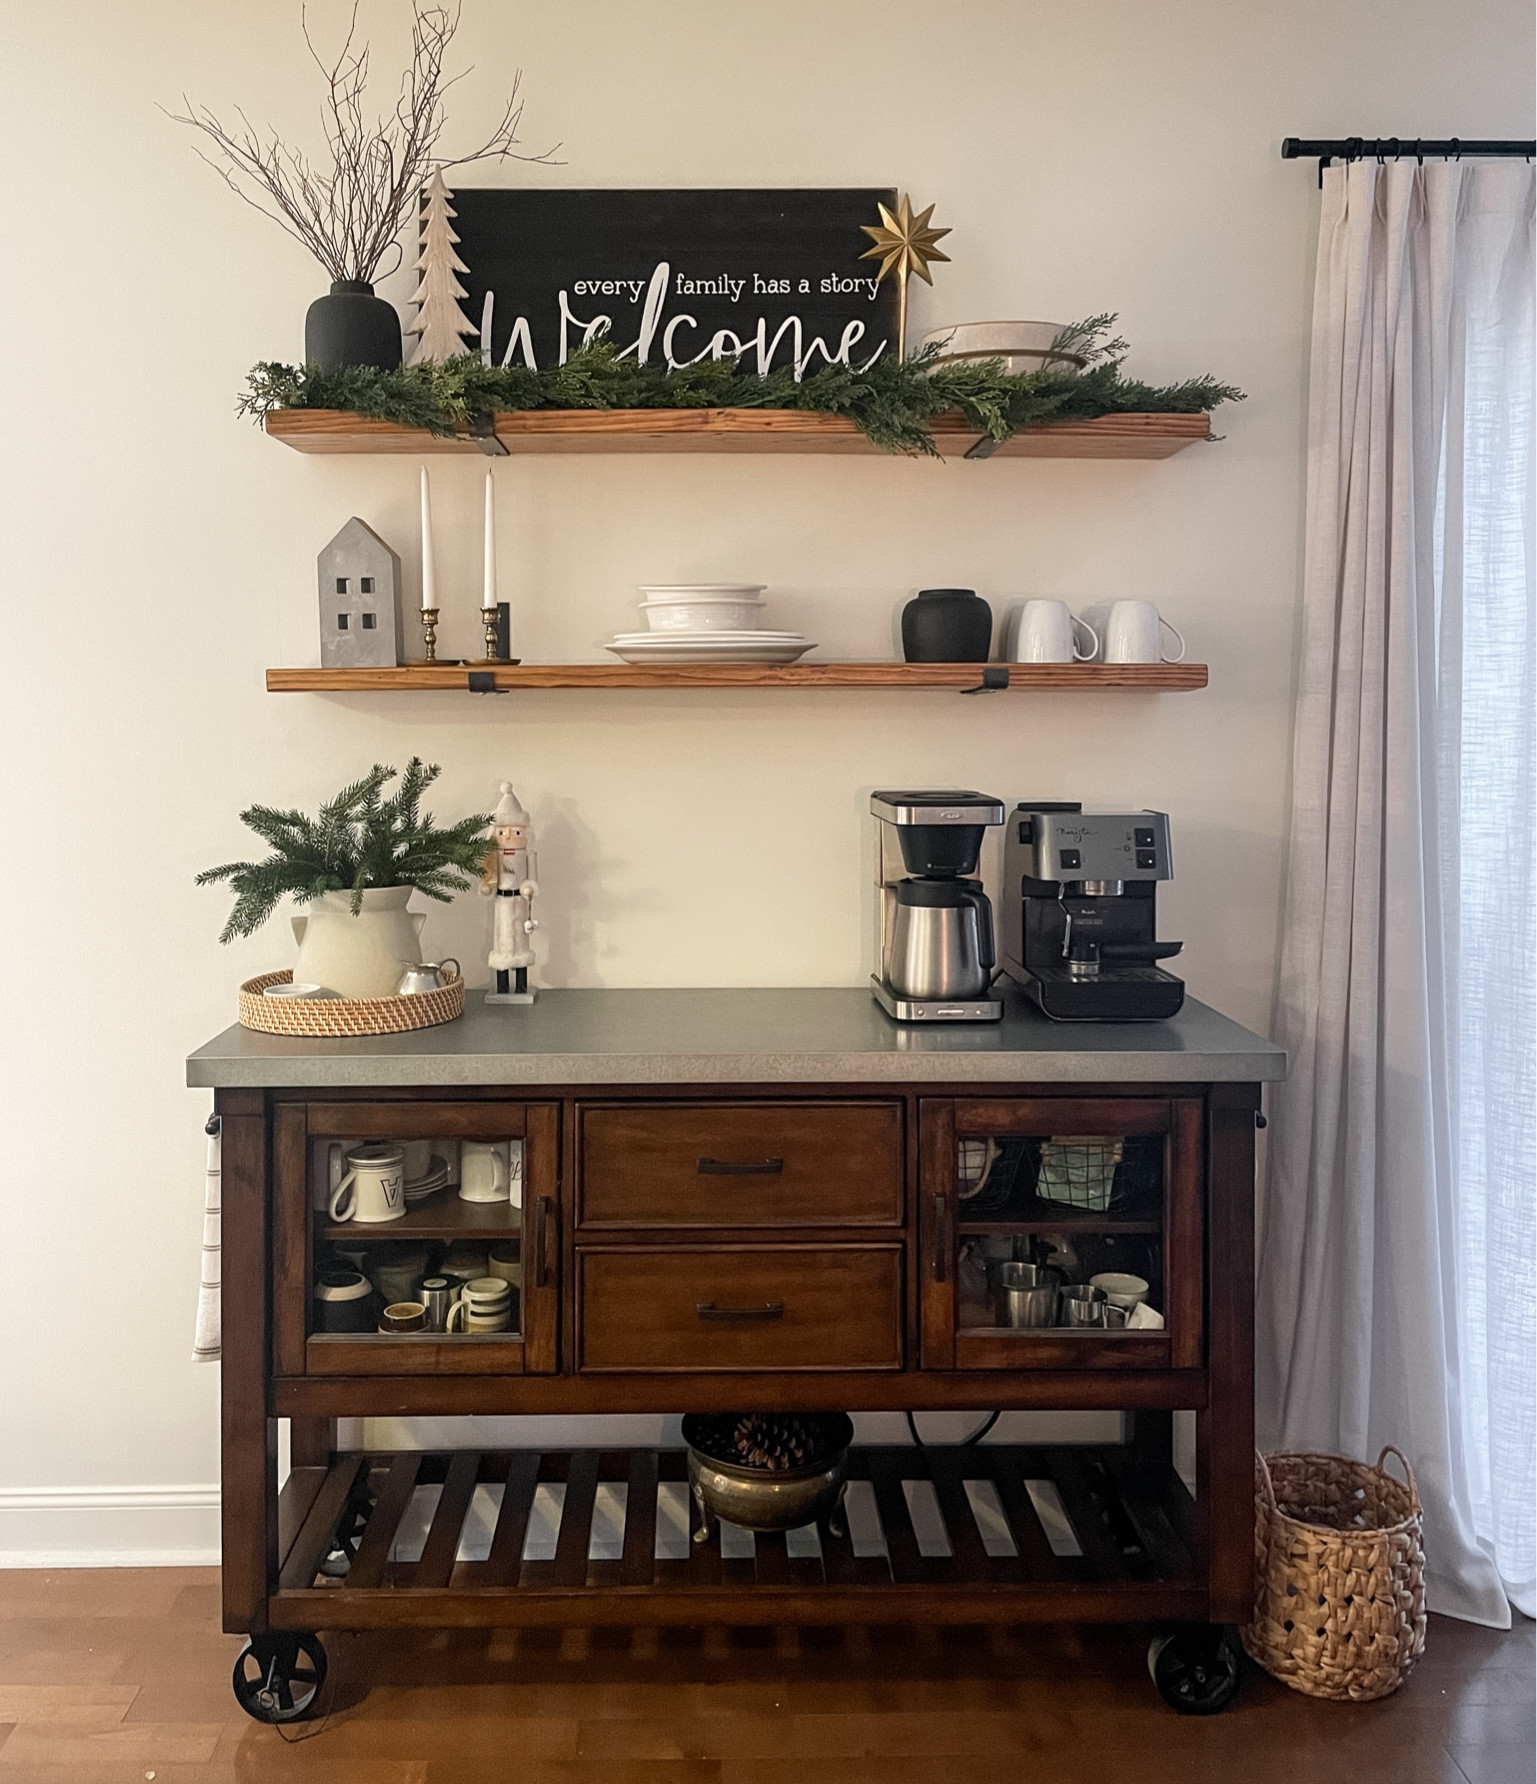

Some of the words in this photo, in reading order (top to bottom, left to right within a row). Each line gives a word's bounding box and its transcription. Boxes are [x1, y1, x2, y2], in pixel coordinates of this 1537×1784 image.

[480, 261, 888, 383] Welcome
[574, 280, 646, 304] every
[676, 272, 747, 302] family
[753, 273, 791, 294] has
[798, 278, 811, 294] a
[820, 272, 879, 301] story
